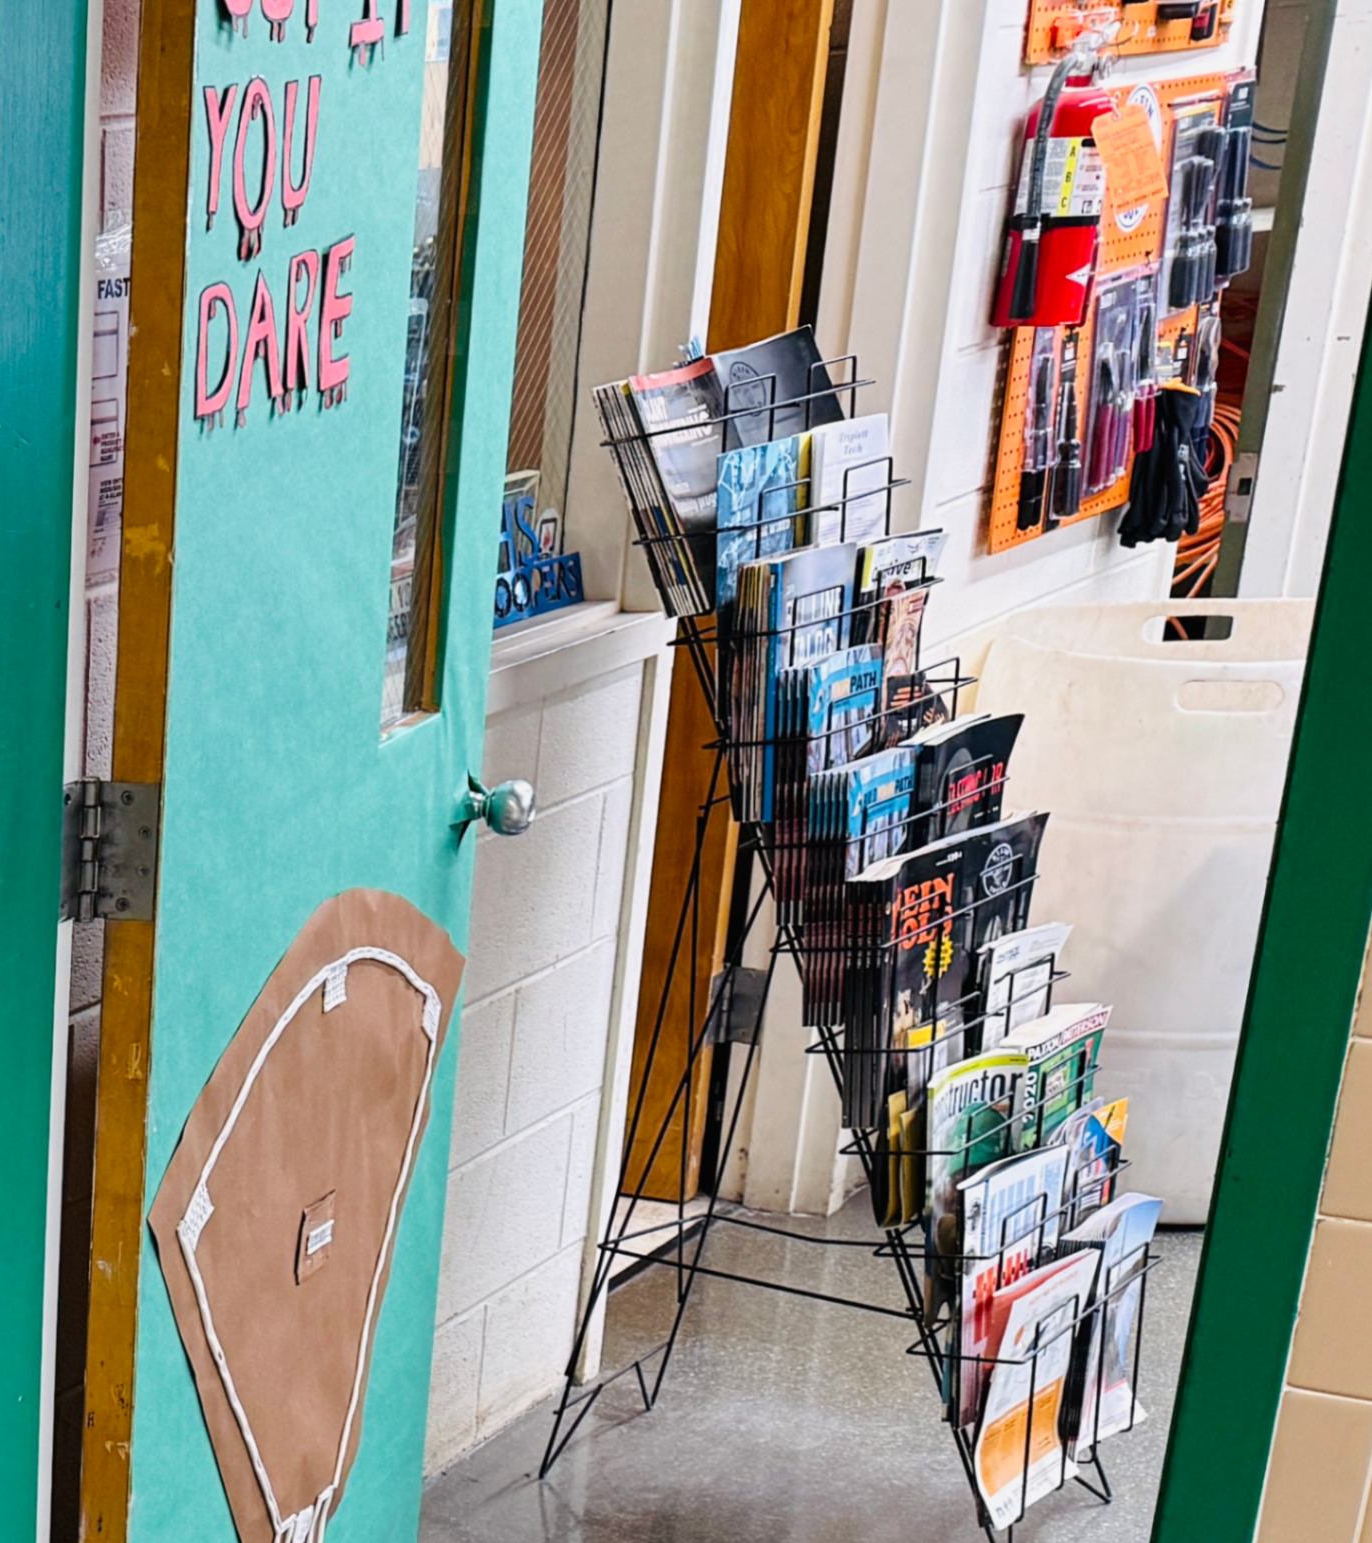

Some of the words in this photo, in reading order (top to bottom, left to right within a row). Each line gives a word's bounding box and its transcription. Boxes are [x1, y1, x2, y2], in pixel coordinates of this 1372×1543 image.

[203, 75, 322, 240] YOU
[195, 233, 355, 422] DARE
[850, 671, 877, 694] PATH
